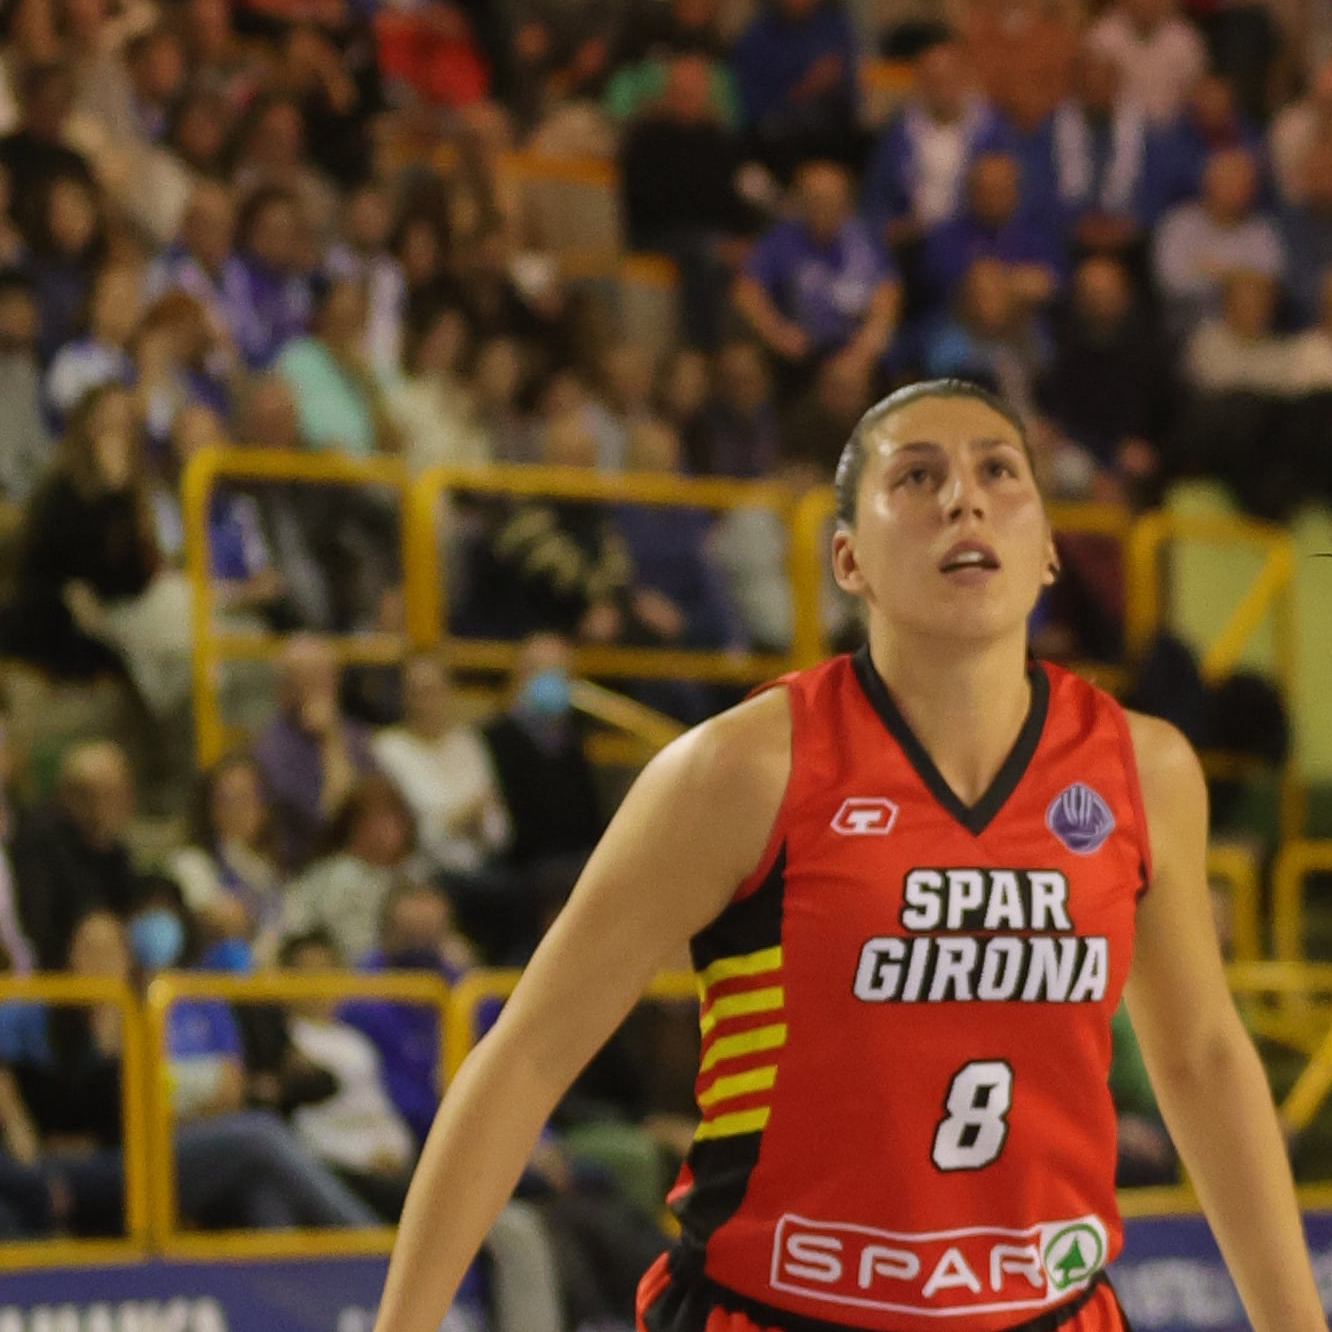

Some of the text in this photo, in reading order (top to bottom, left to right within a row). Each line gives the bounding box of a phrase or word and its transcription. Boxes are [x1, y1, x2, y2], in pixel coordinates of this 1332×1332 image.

[901, 868, 1074, 933] SPAR
[852, 935, 1110, 1003] GIRONA
[932, 1059, 1014, 1172] 8
[783, 1233, 1045, 1297] SPAR
